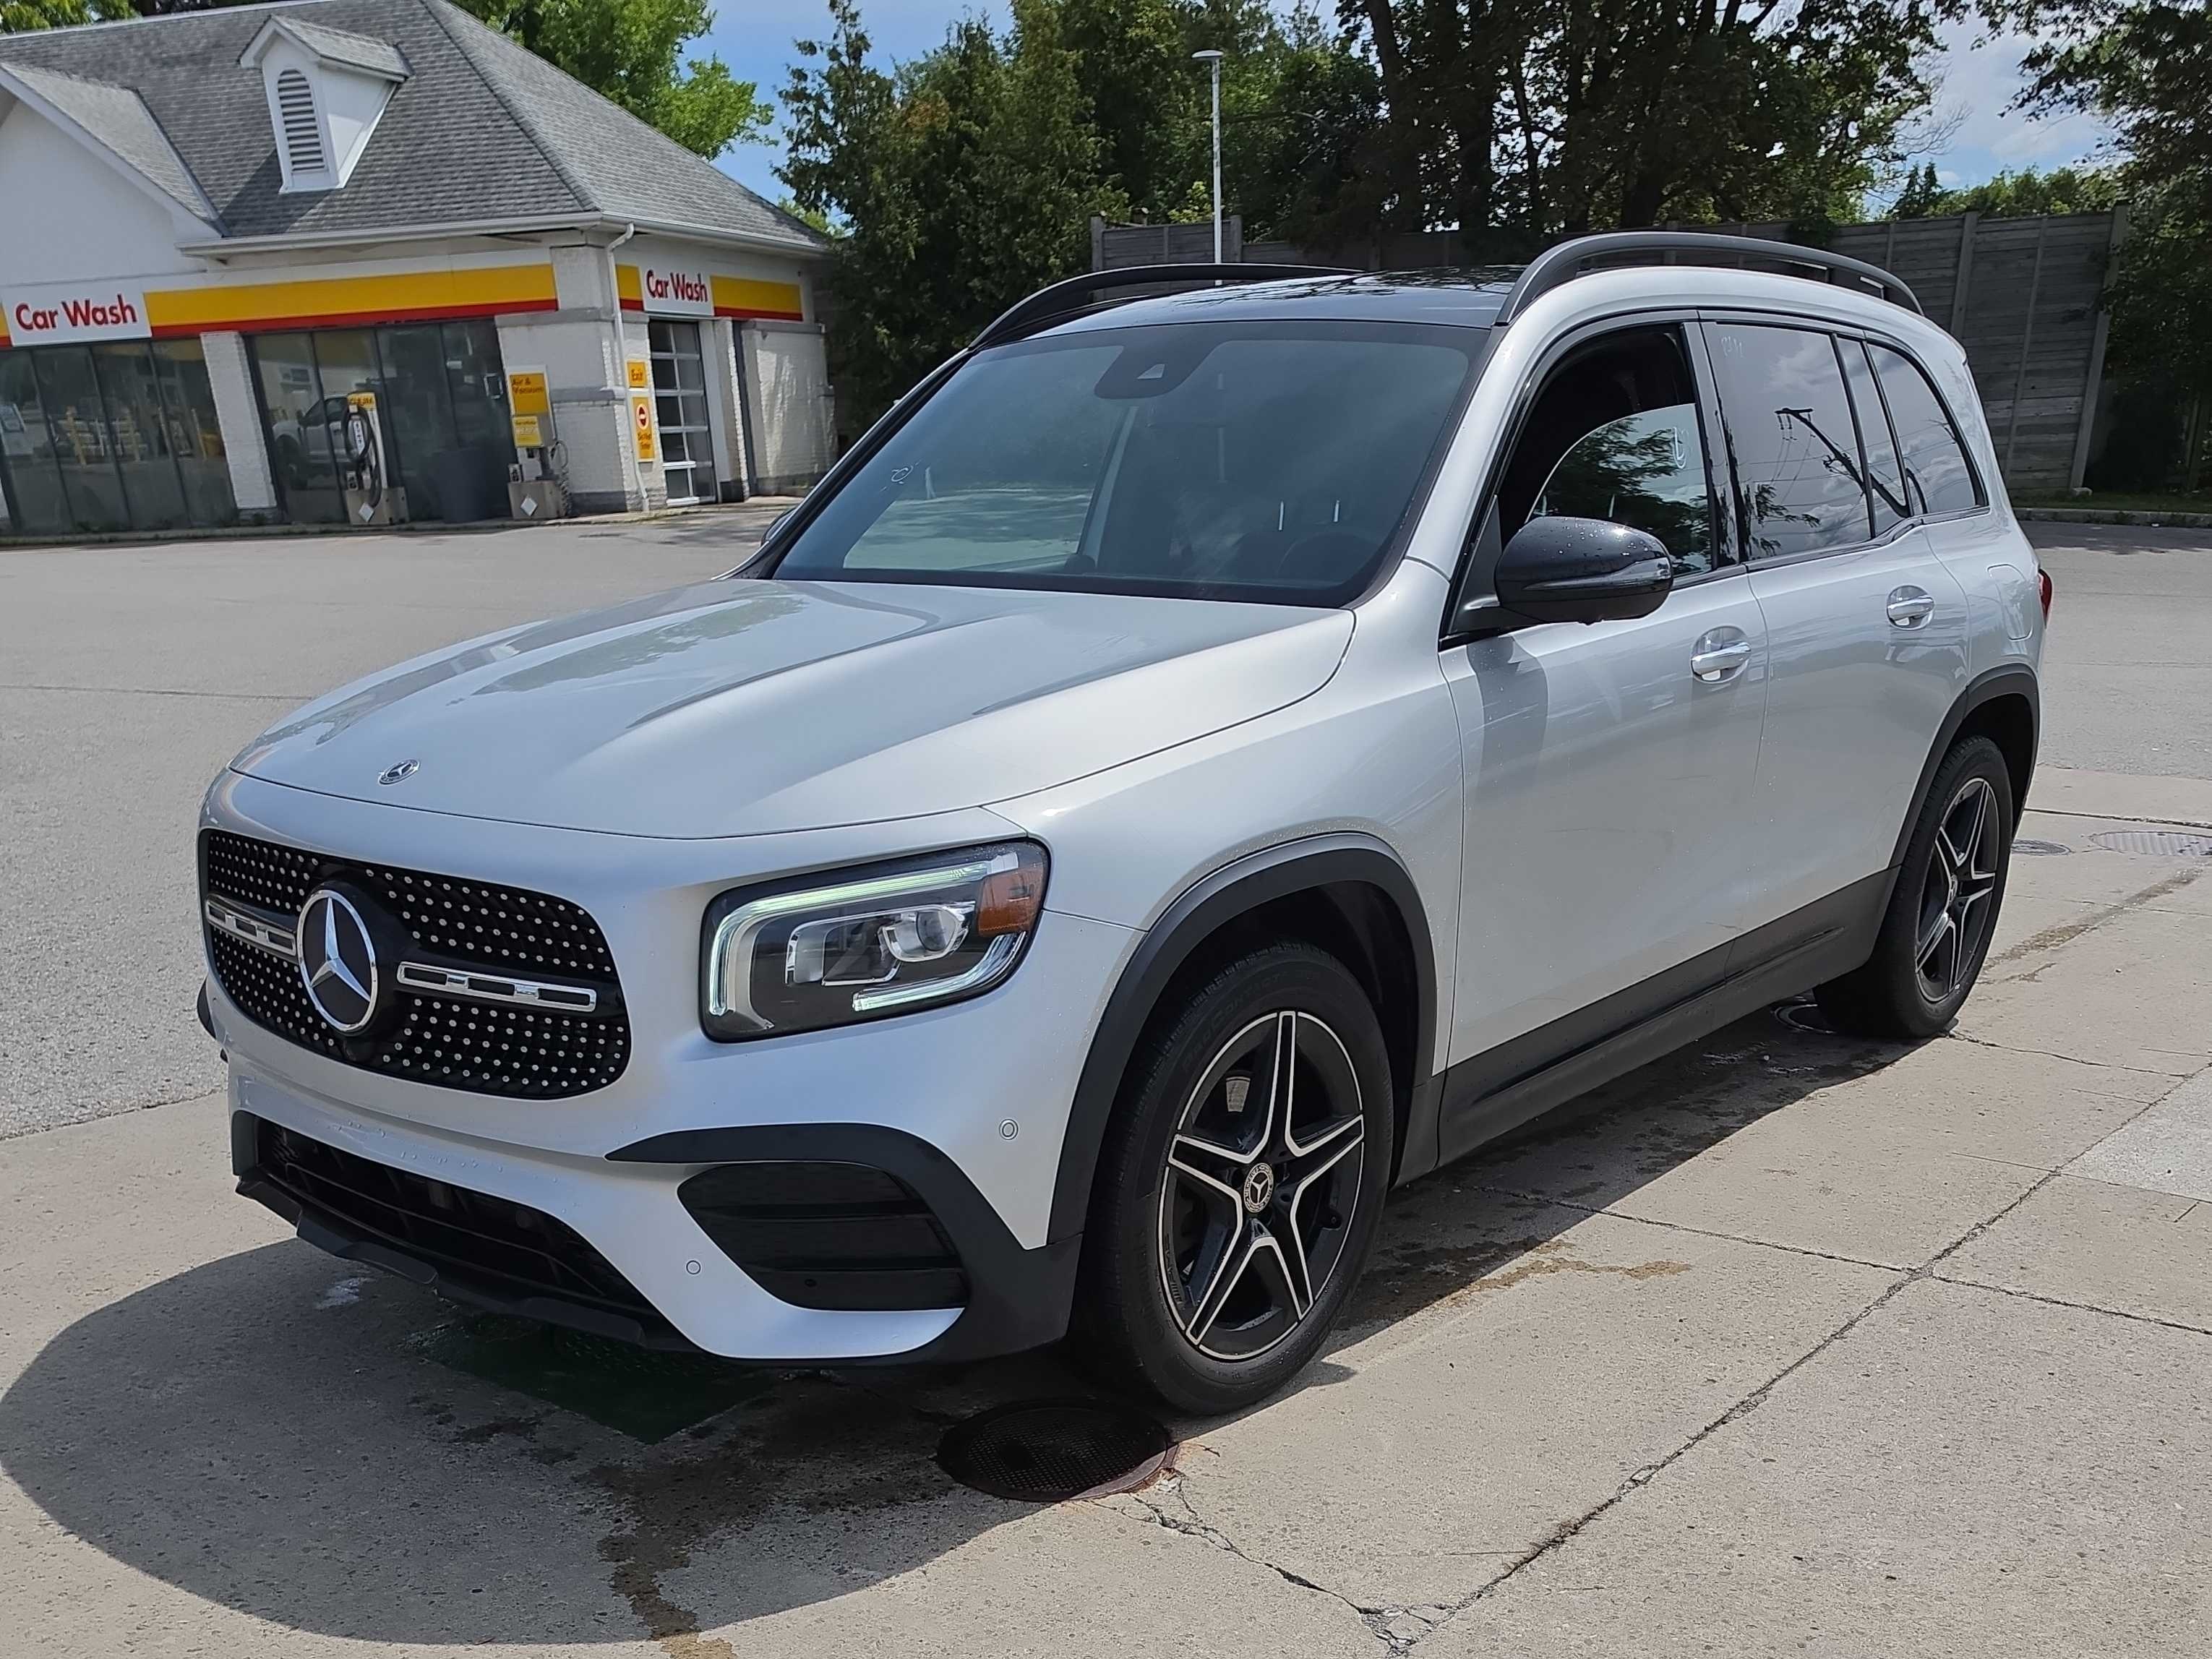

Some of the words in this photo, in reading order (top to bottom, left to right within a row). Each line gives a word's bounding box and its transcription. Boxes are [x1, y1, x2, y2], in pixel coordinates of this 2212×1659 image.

[646, 269, 669, 299] Car
[669, 272, 708, 303] Wash
[15, 303, 59, 330] Car
[61, 293, 137, 327] Wash
